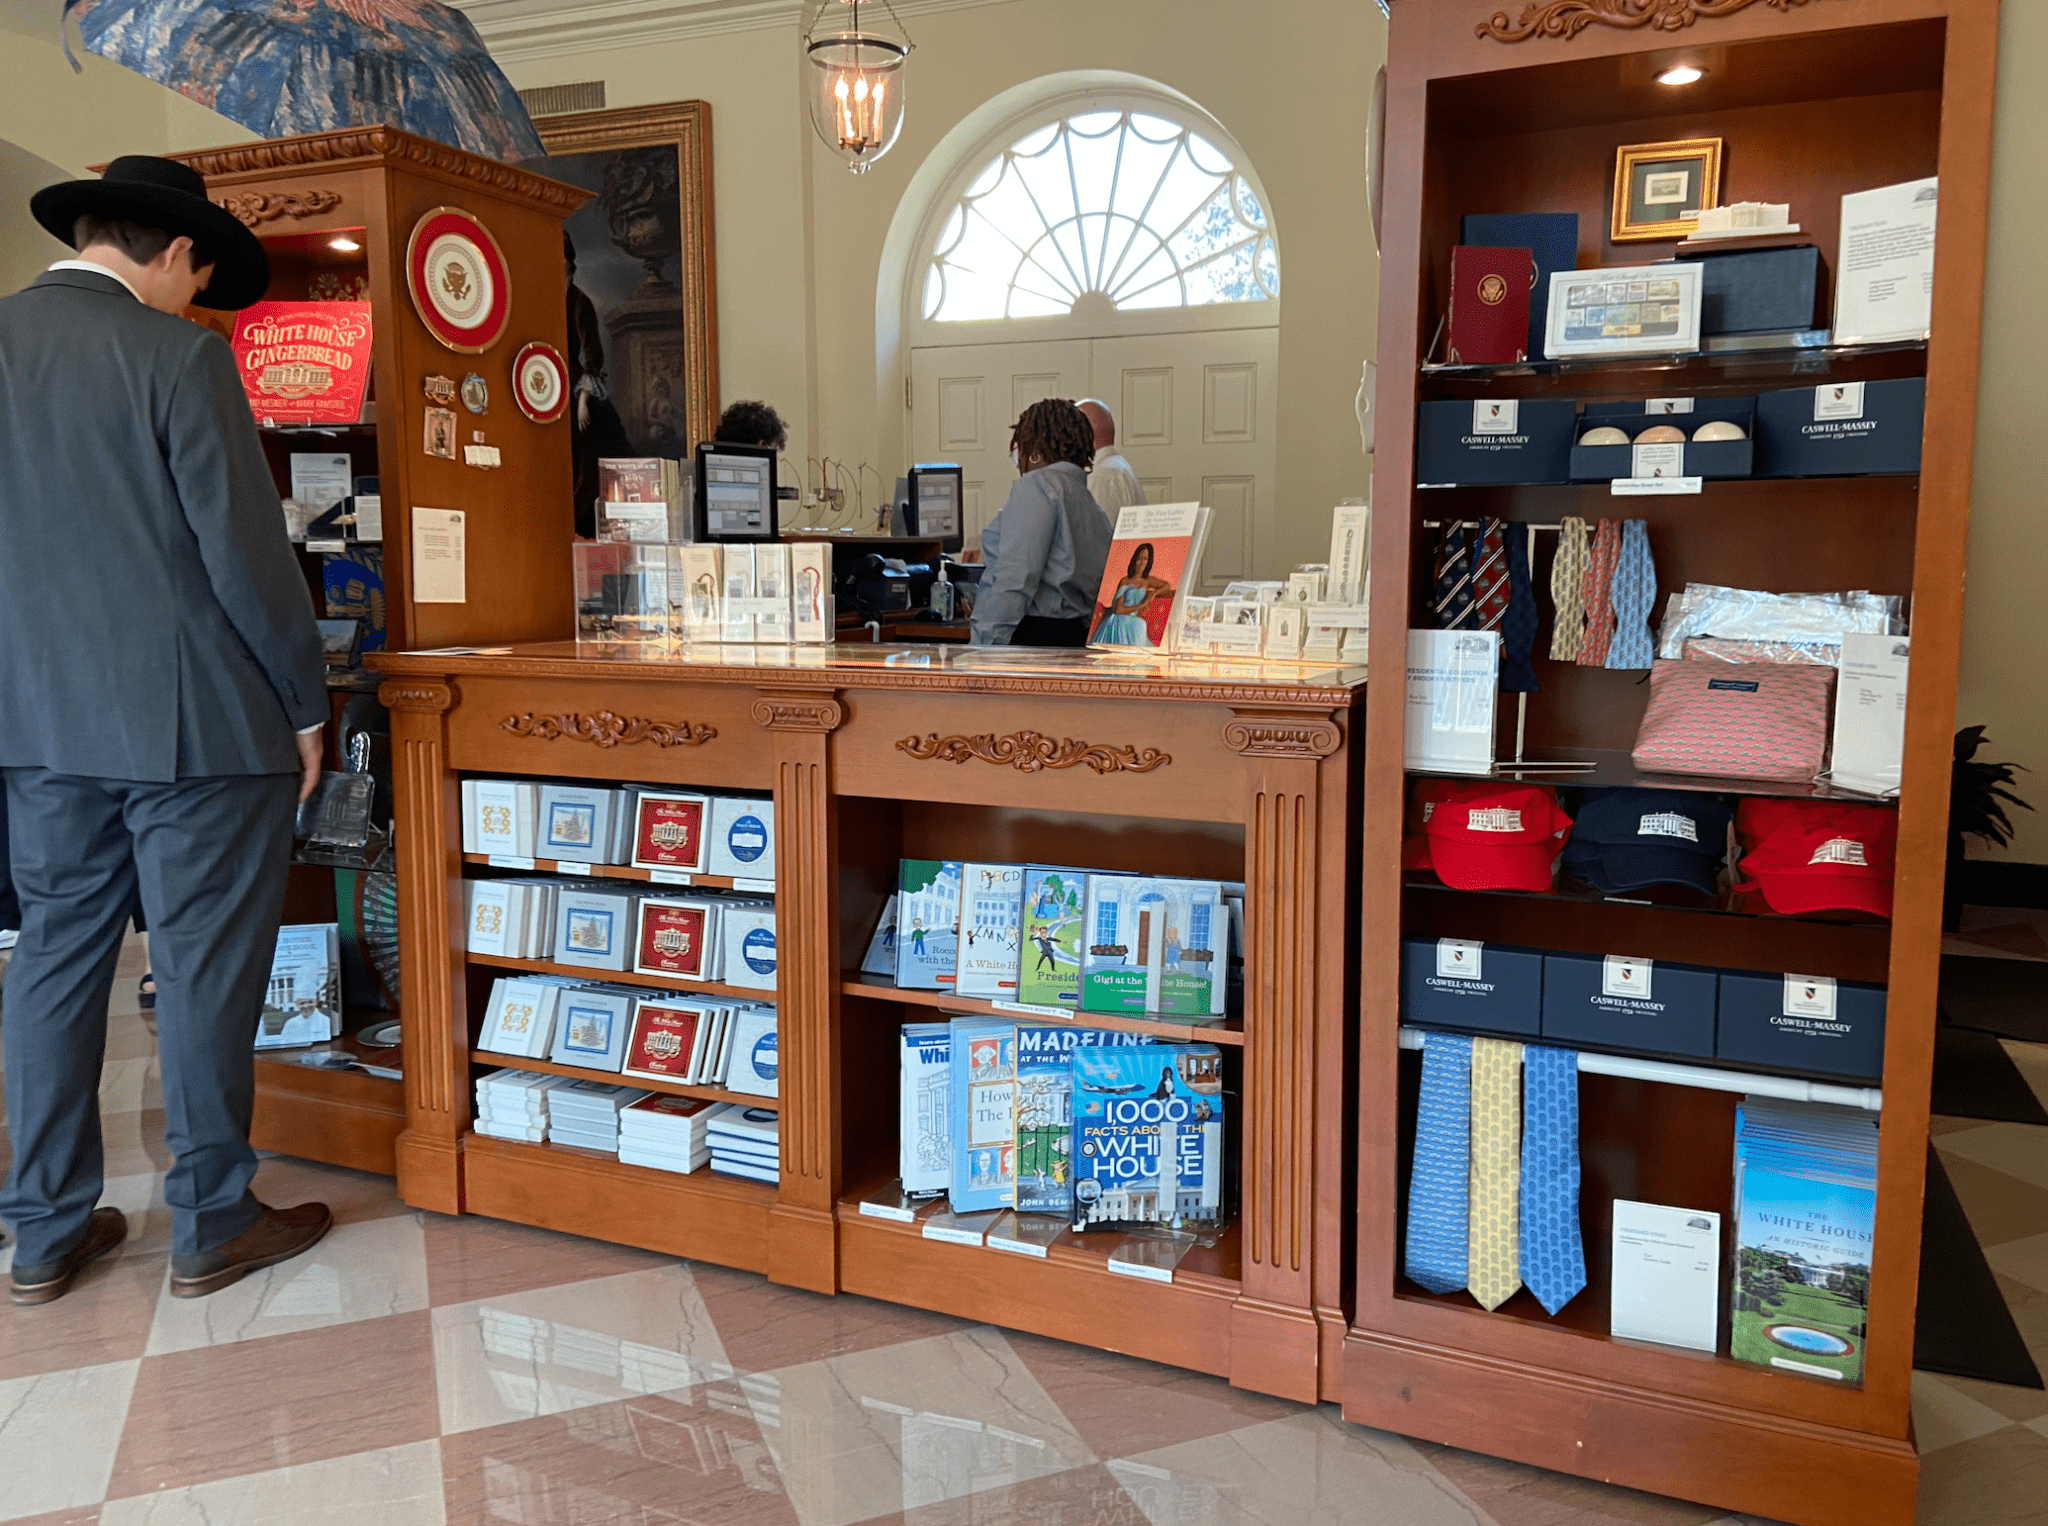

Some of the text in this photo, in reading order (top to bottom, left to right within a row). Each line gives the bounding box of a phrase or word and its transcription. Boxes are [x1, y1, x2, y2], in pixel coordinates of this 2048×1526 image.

[250, 323, 358, 348] WHITE HOUSE
[246, 344, 353, 371] GINGERBREAD
[1801, 420, 1877, 434] CASWELL-MASSEY
[1461, 435, 1530, 444] CASWELL-MASSEY
[1449, 669, 1489, 677] COLLECTION
[918, 956, 939, 964] with
[966, 960, 974, 968] A
[975, 960, 1005, 969] White
[1093, 975, 1113, 985] Gigi
[1127, 977, 1143, 985] the
[1425, 977, 1496, 992] CASWELL-MASSEY
[1590, 996, 1666, 1011] CASWELL-MASSEY
[1770, 1016, 1852, 1033] CASWELL-MASSEY
[1020, 1055, 1032, 1063] AT
[1036, 1055, 1054, 1063] THE
[980, 1090, 1013, 1104] How
[976, 1107, 1004, 1122] The
[1107, 1099, 1189, 1125] 1,000
[1084, 1126, 1129, 1137] FACTS
[1182, 1124, 1205, 1134] TH
[1095, 1134, 1200, 1157] WHIE
[1758, 1212, 1815, 1232] WHITE
[1807, 1212, 1829, 1221] THE
[1783, 1237, 1830, 1252] HISTORIC
[1832, 1247, 1866, 1259] GUIDE
